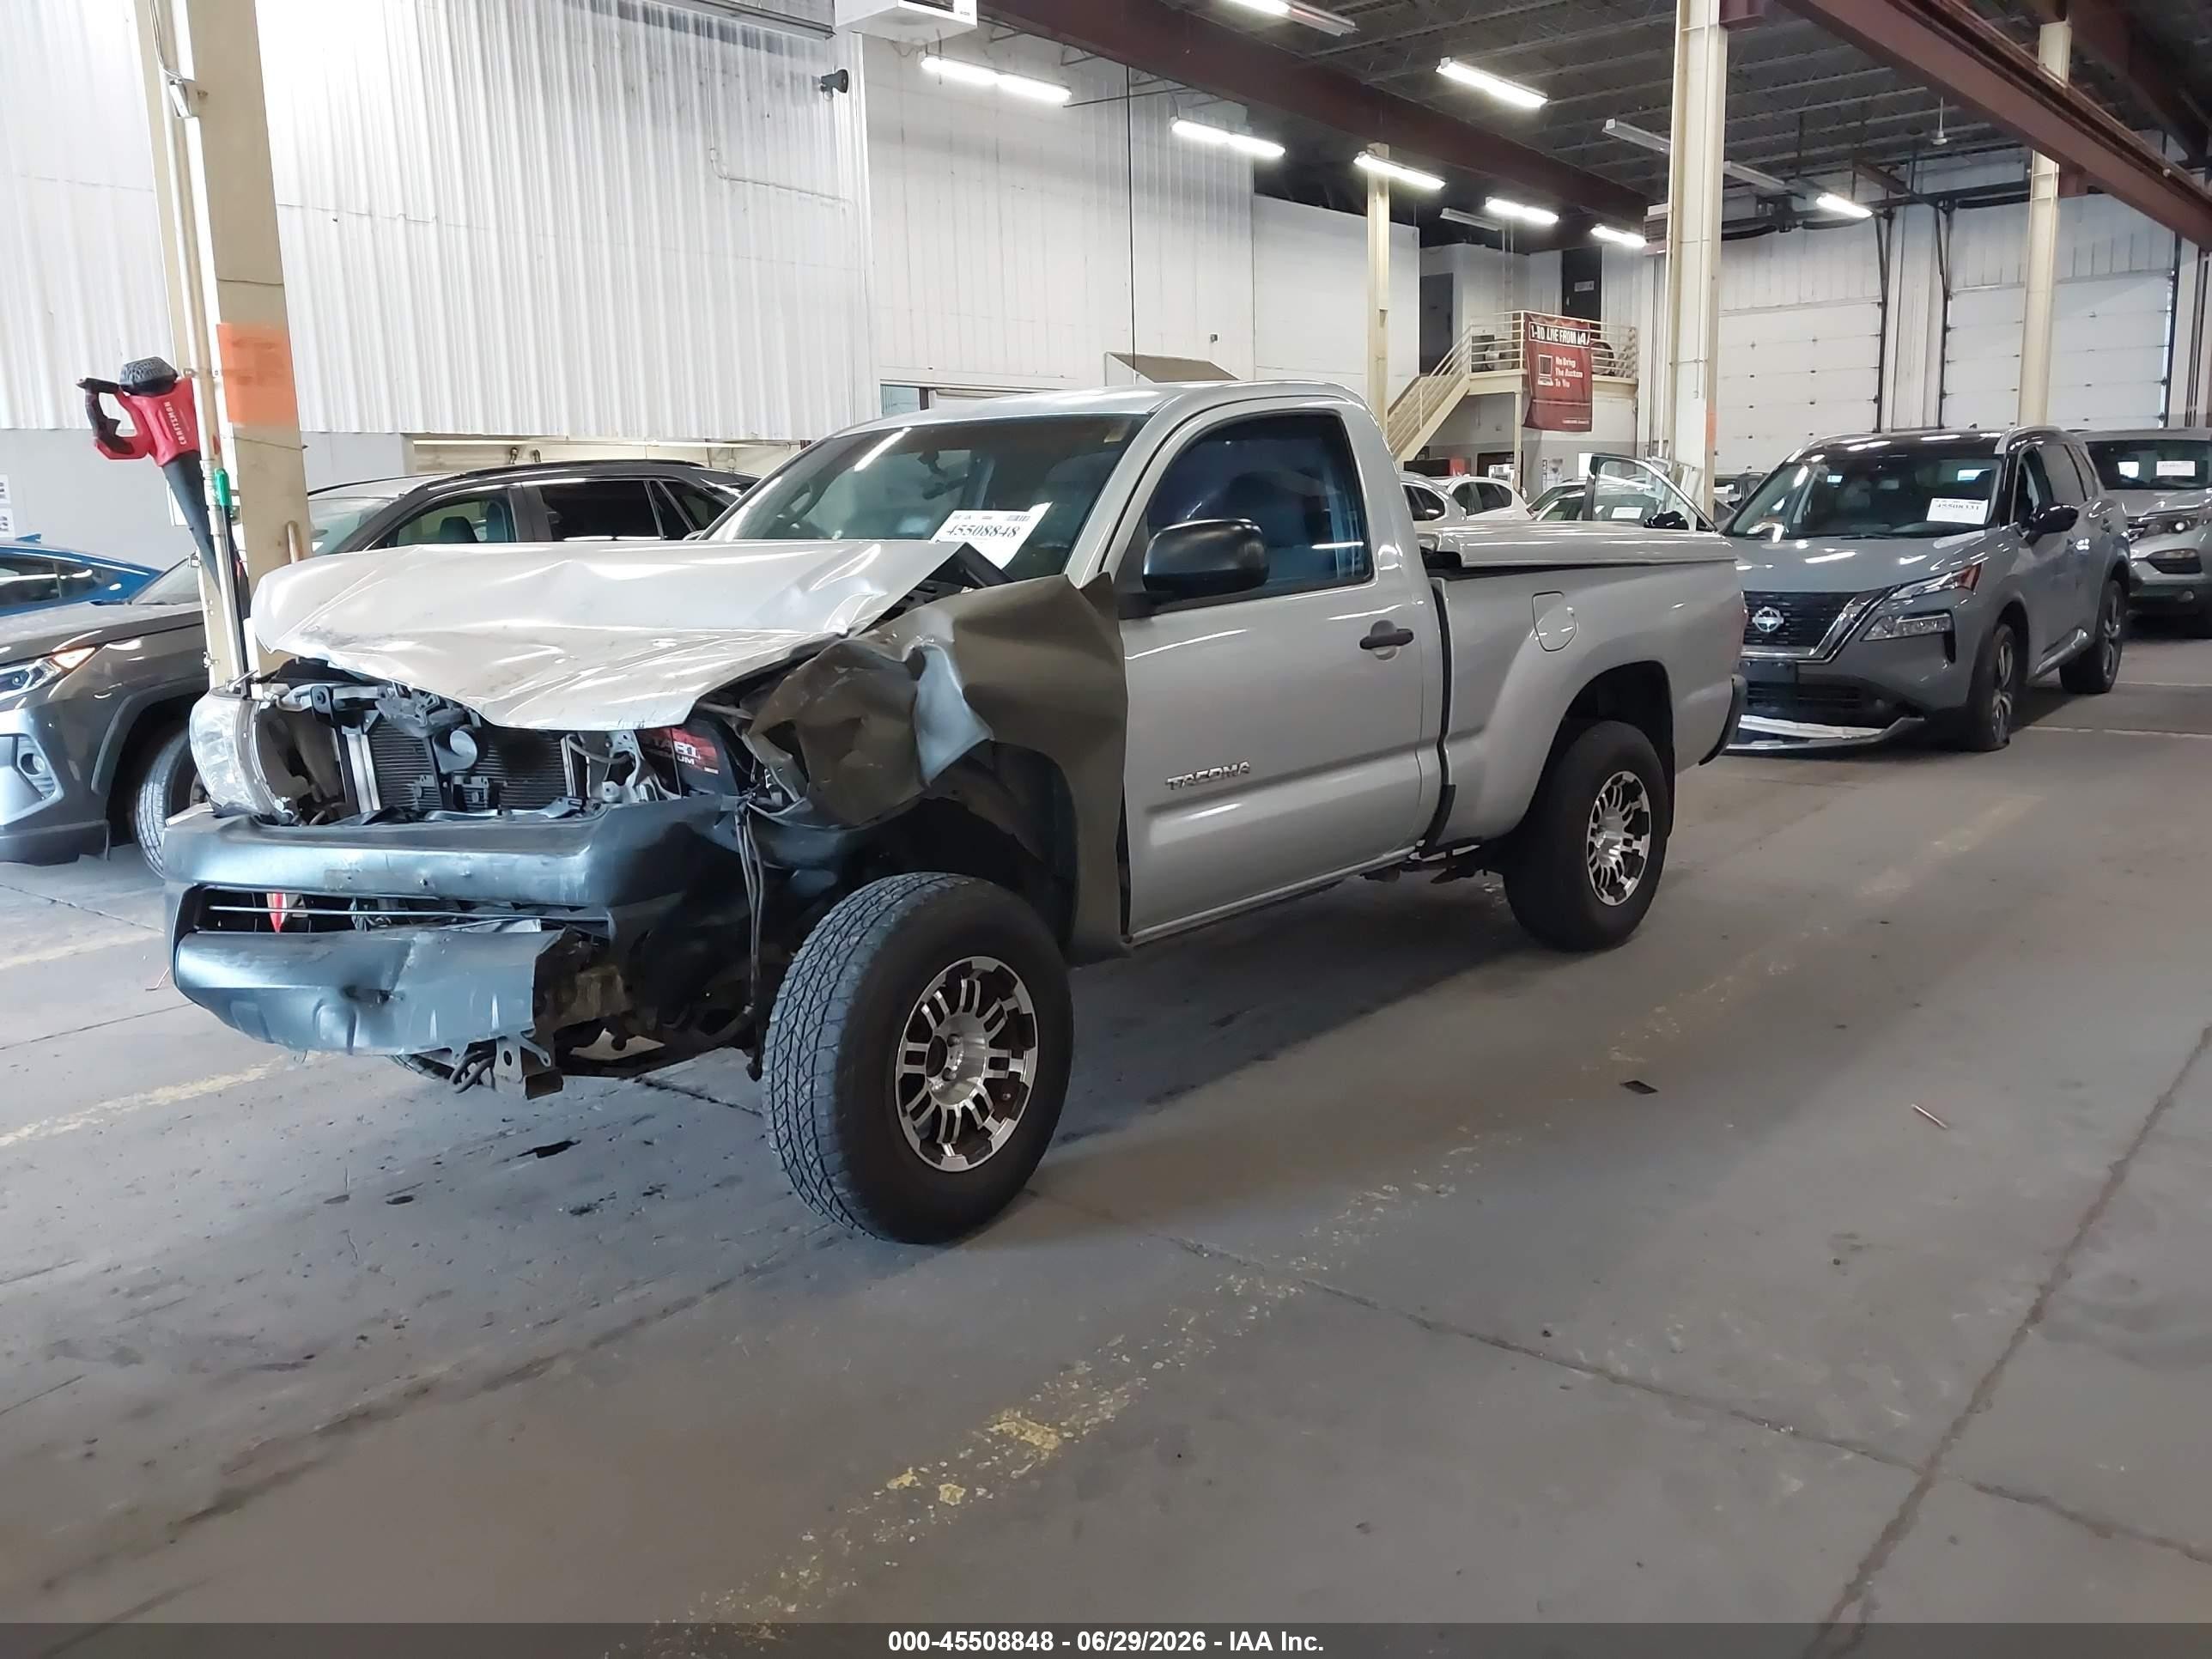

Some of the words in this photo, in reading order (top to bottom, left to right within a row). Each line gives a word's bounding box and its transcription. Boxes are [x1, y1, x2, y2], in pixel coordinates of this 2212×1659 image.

[1559, 329, 1577, 343] FROM
[945, 524, 1021, 538] 45508848
[1165, 761, 1251, 790] TACOMA
